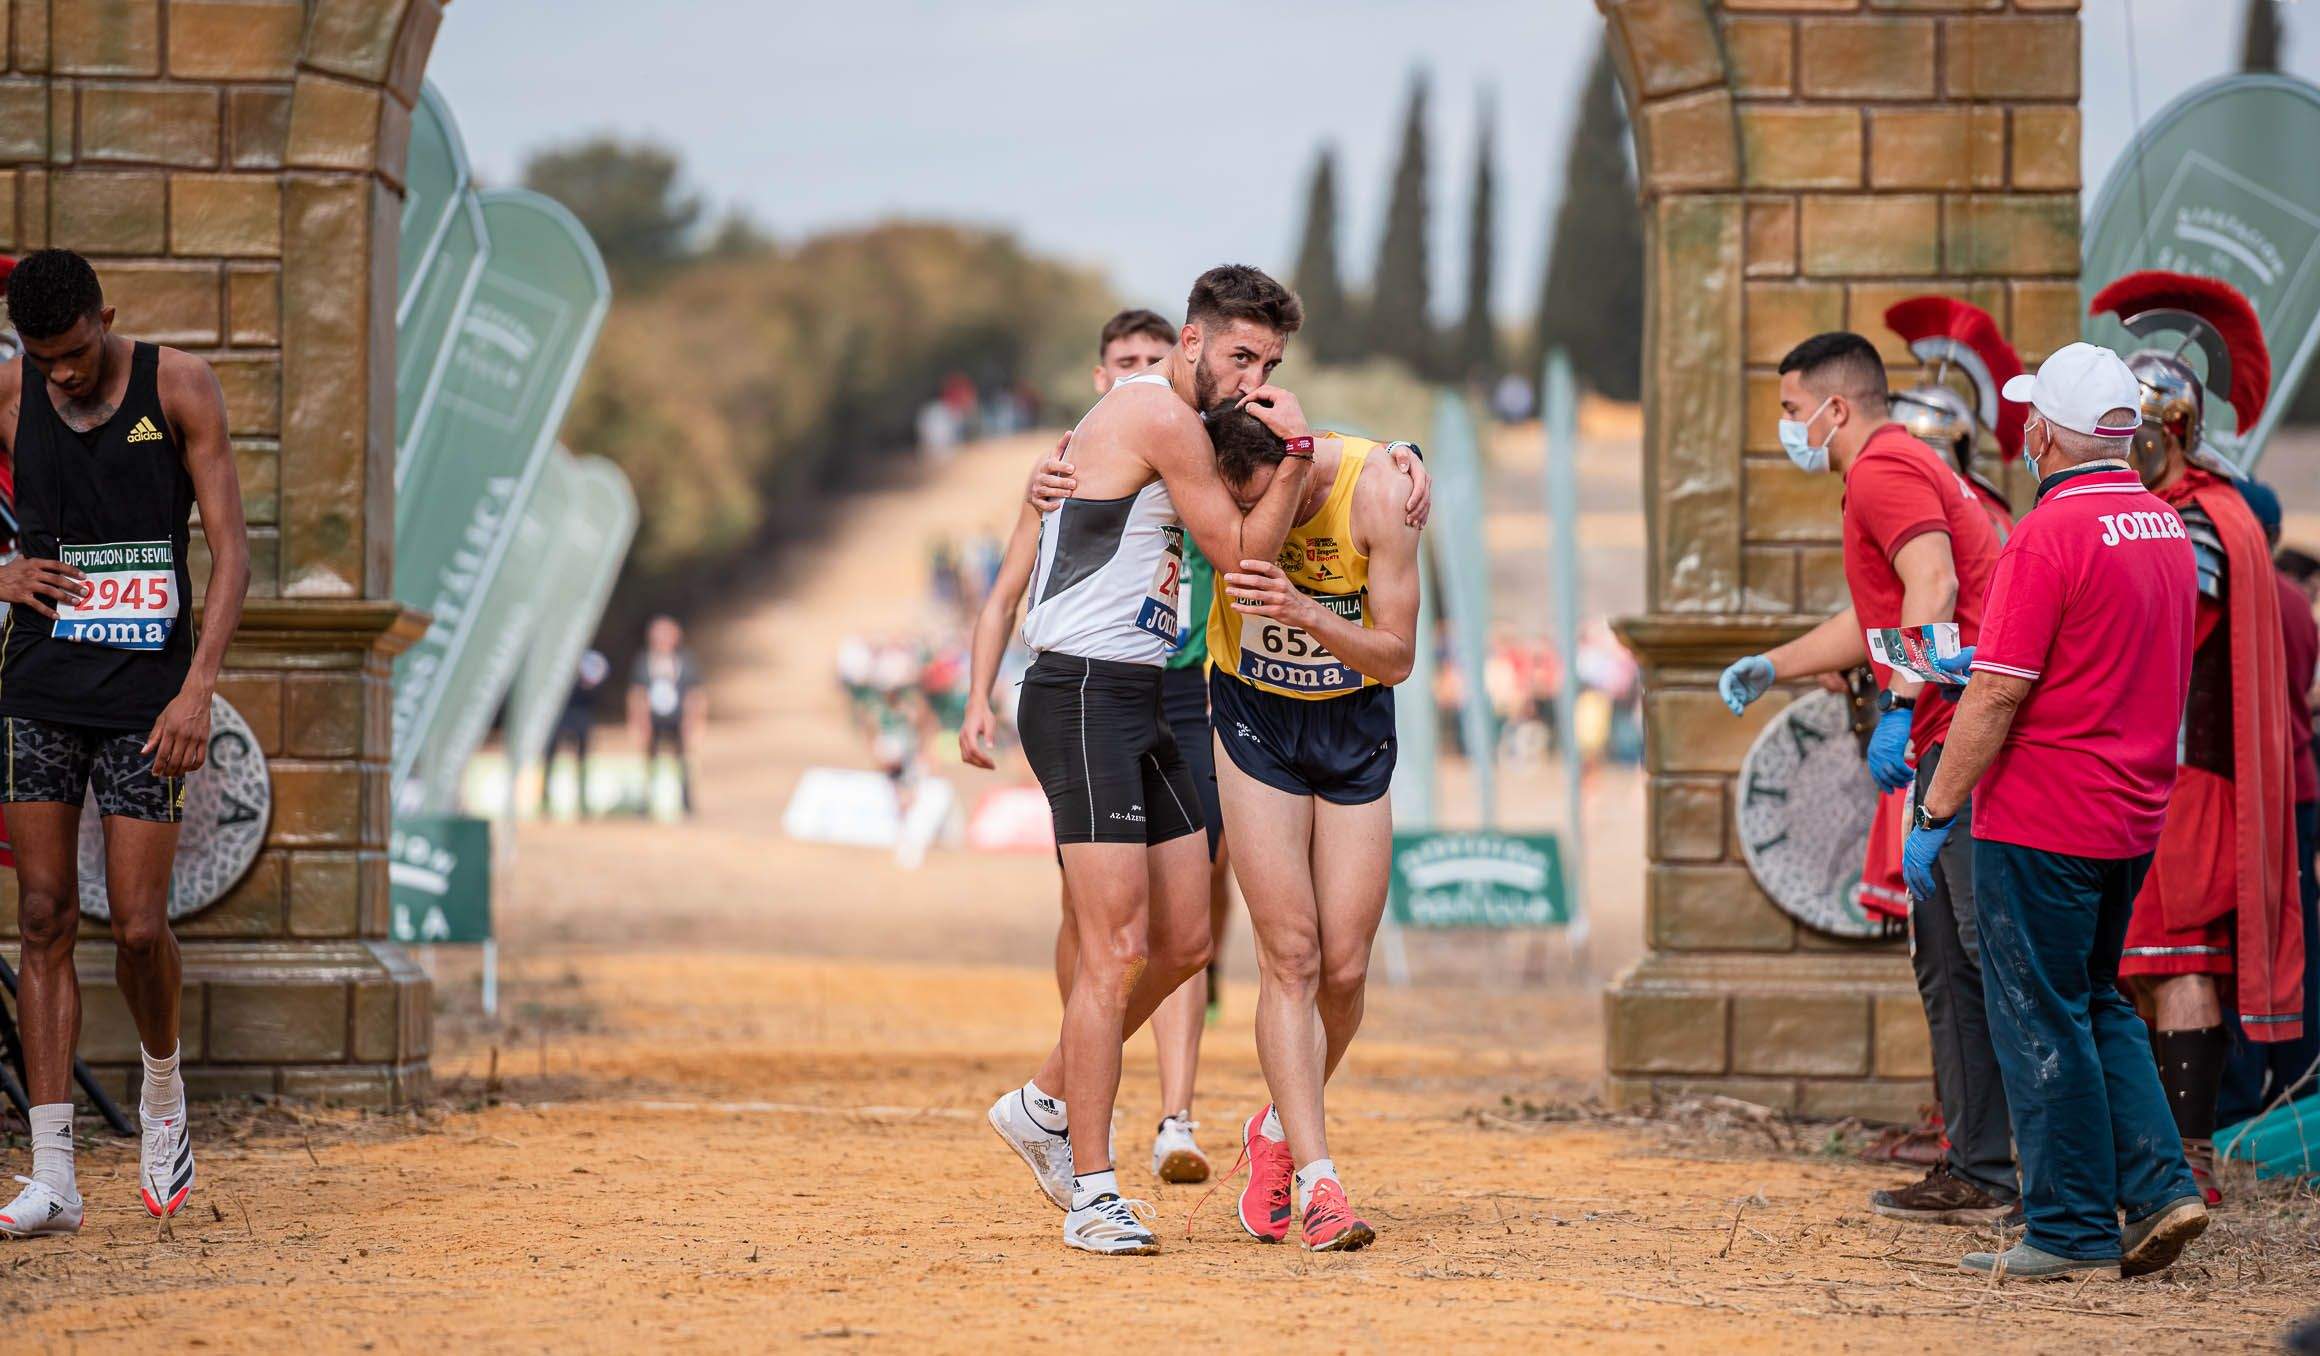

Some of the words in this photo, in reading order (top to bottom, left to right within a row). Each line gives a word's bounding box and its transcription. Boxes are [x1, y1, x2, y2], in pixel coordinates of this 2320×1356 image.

[127, 431, 163, 443] adidas
[64, 549, 122, 567] DIPUTACION
[126, 548, 139, 563] DE
[142, 547, 173, 563] SEVILL
[74, 578, 168, 611] 2945
